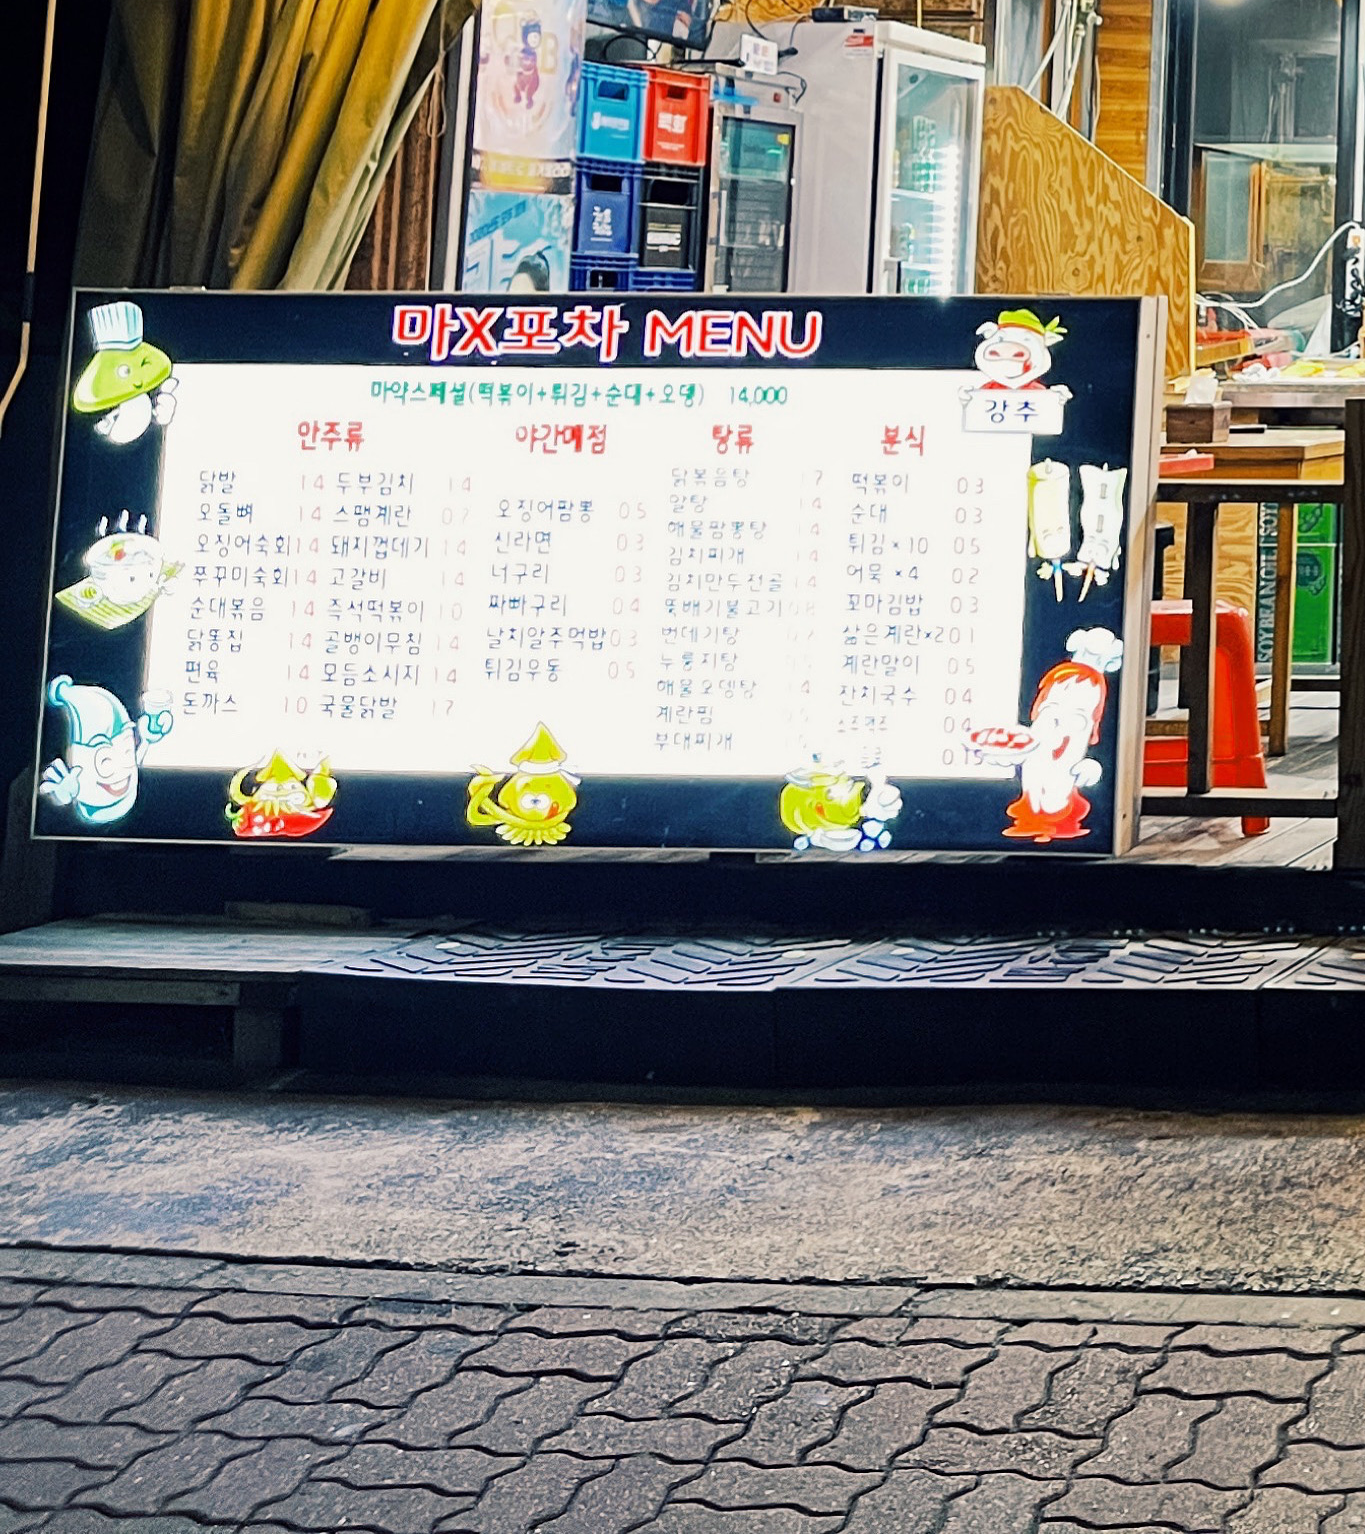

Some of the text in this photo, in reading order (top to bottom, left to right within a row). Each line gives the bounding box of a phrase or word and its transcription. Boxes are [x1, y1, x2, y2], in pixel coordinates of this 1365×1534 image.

[391, 302, 823, 363] 마X포차 MENU
[729, 385, 789, 405] 14,000
[985, 400, 1039, 423] 강추
[297, 420, 365, 452] 안주류
[515, 423, 607, 454] 야간매점
[711, 423, 755, 454] 탕류
[881, 424, 925, 456] 분식
[199, 470, 236, 494] 닭발
[336, 472, 414, 496] 두부김치
[852, 473, 909, 495] 떡볶이
[197, 502, 253, 525] 오돌뼈
[496, 498, 595, 523] 오징어짬뽕
[851, 503, 887, 524] 순대
[195, 534, 290, 558] 오징어숙회
[331, 535, 429, 560] 돼지껍데기
[495, 531, 552, 554] 신라면
[329, 568, 386, 590] 고갈비
[491, 563, 549, 584] 너구리
[847, 563, 881, 584] 어묵
[191, 596, 265, 621] 순대볶음
[327, 598, 424, 622] 즉석떡볶이
[846, 593, 924, 616] 꼬마김밥
[187, 628, 243, 653] 닭똥집
[325, 631, 422, 655] 골뱅이무침
[486, 626, 607, 651] 날치알주먹밥
[185, 659, 220, 684] 편육
[321, 662, 420, 687] 모듬소시지
[484, 658, 562, 682] 튀김우동
[842, 653, 919, 677] 계란말이
[182, 691, 239, 715] 돈까스
[320, 694, 398, 719] 국물닭발
[839, 684, 918, 706] 잔치국수
